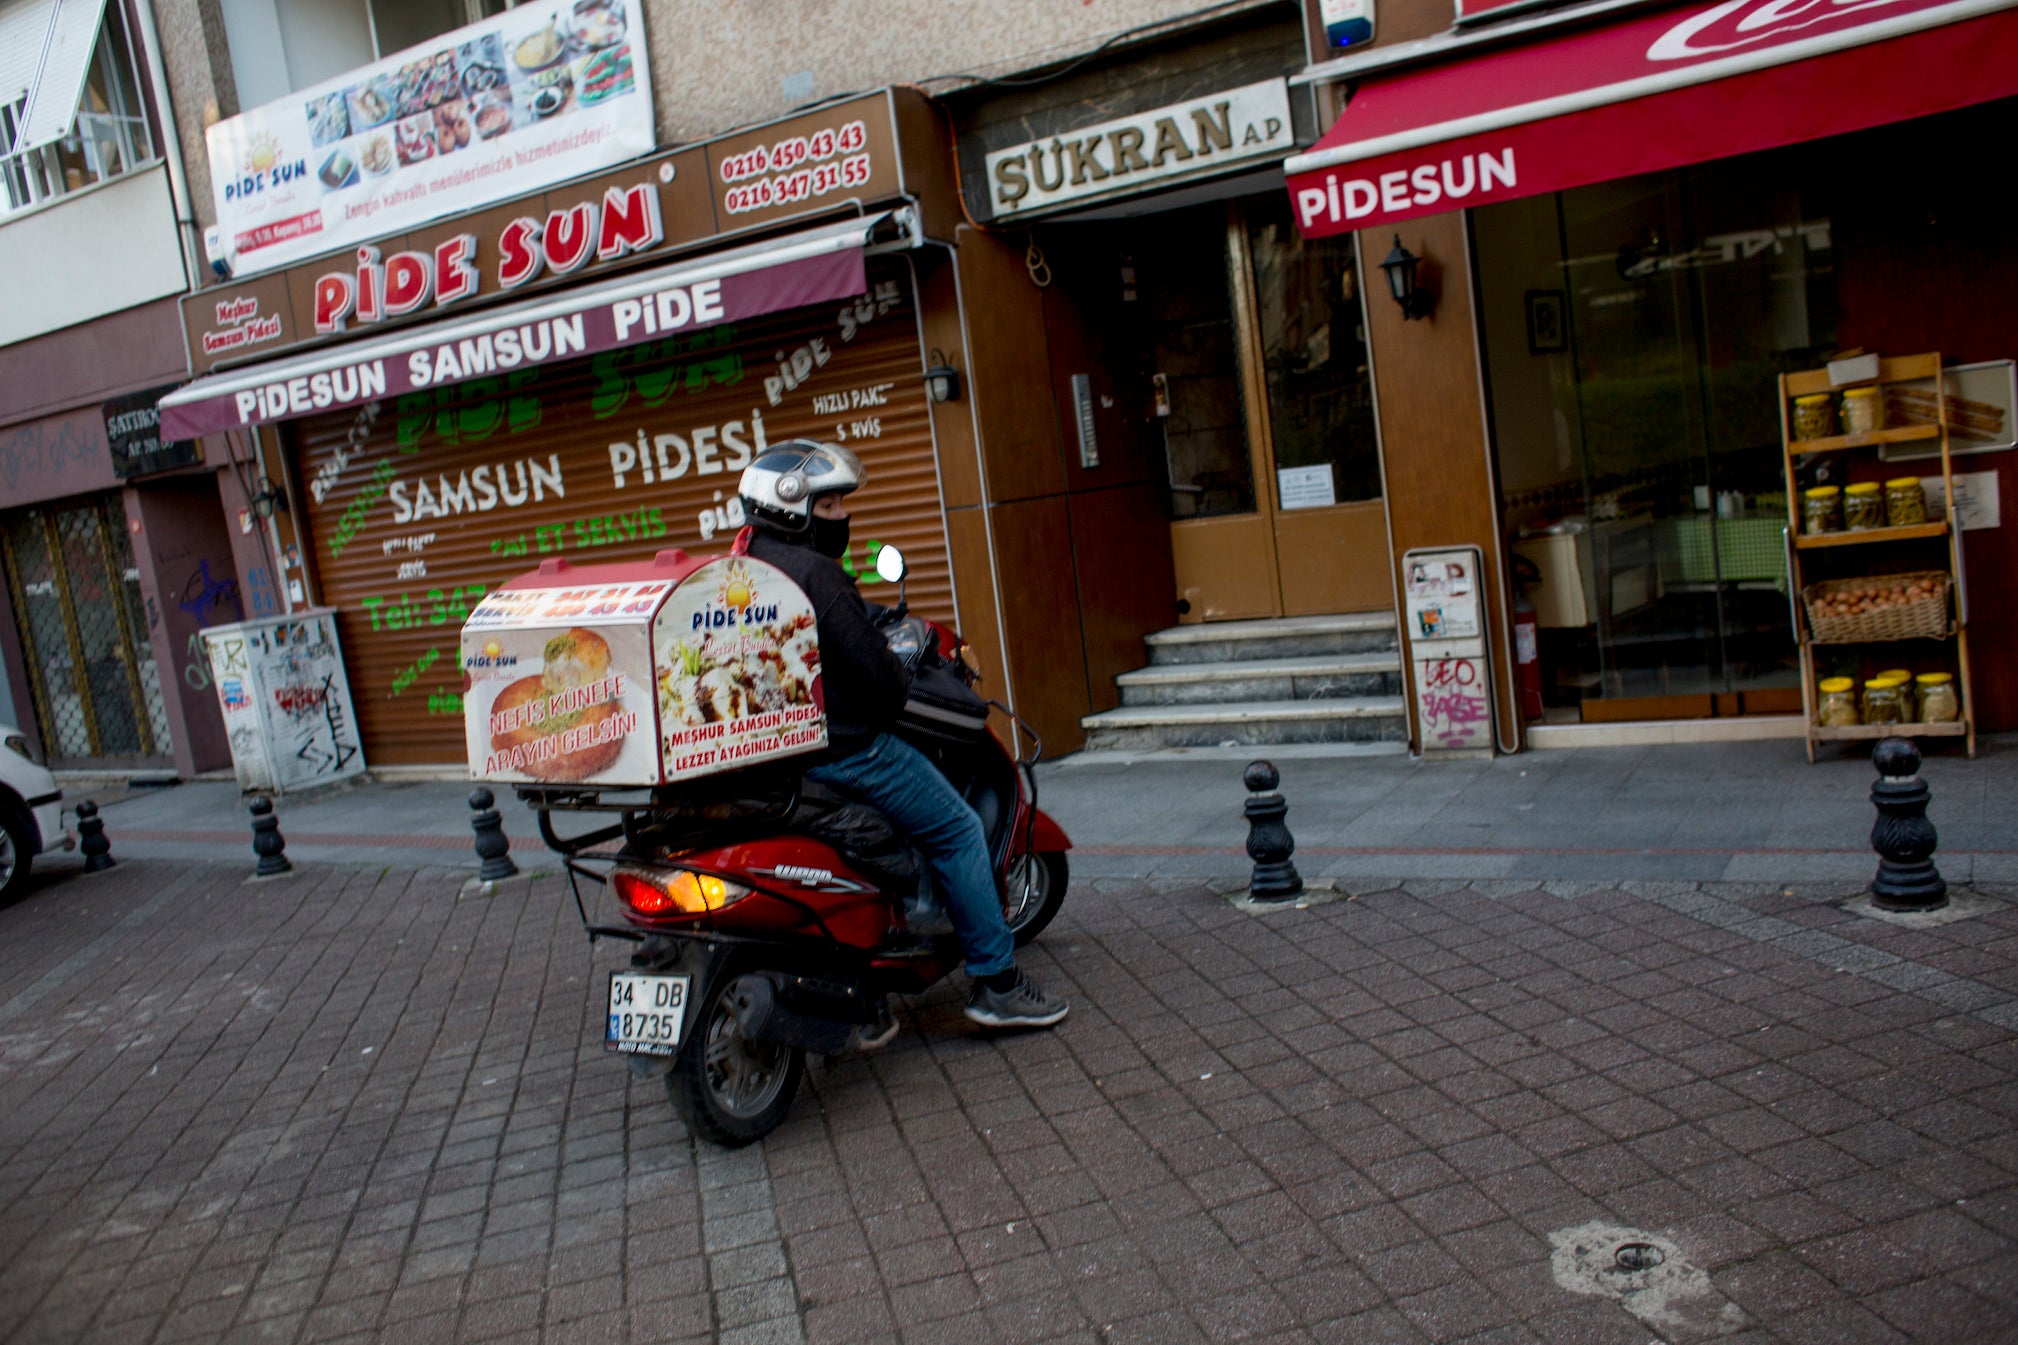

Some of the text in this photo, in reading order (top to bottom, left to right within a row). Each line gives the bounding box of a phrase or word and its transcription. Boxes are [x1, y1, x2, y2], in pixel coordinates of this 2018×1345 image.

[722, 125, 863, 180] 0216 450 43 43
[995, 101, 1281, 209] ŞÜKRAN AP
[225, 158, 307, 201] PİDE SUN
[727, 158, 868, 211] 0216 347 31 55
[1298, 147, 1517, 228] PİDESUN
[314, 183, 664, 334] PİDE SUN
[203, 314, 281, 354] Samsun Pidesi
[409, 313, 587, 387] SAMSUN
[812, 391, 850, 416] HIZLI
[388, 452, 566, 525] SAMSUN
[361, 592, 422, 632] Tel:
[692, 602, 778, 631] PİDE SUN
[489, 672, 627, 737] NEFİS KÜNEFE
[485, 712, 637, 775] ARAYIN GELSİN!
[671, 724, 726, 750] MEŞHUR
[729, 711, 781, 735] SAMSUN
[675, 724, 820, 771] LEZZET AYAĞINIZA GELSİN!
[614, 981, 682, 1007] 34 DB
[623, 1013, 673, 1039] 8735
